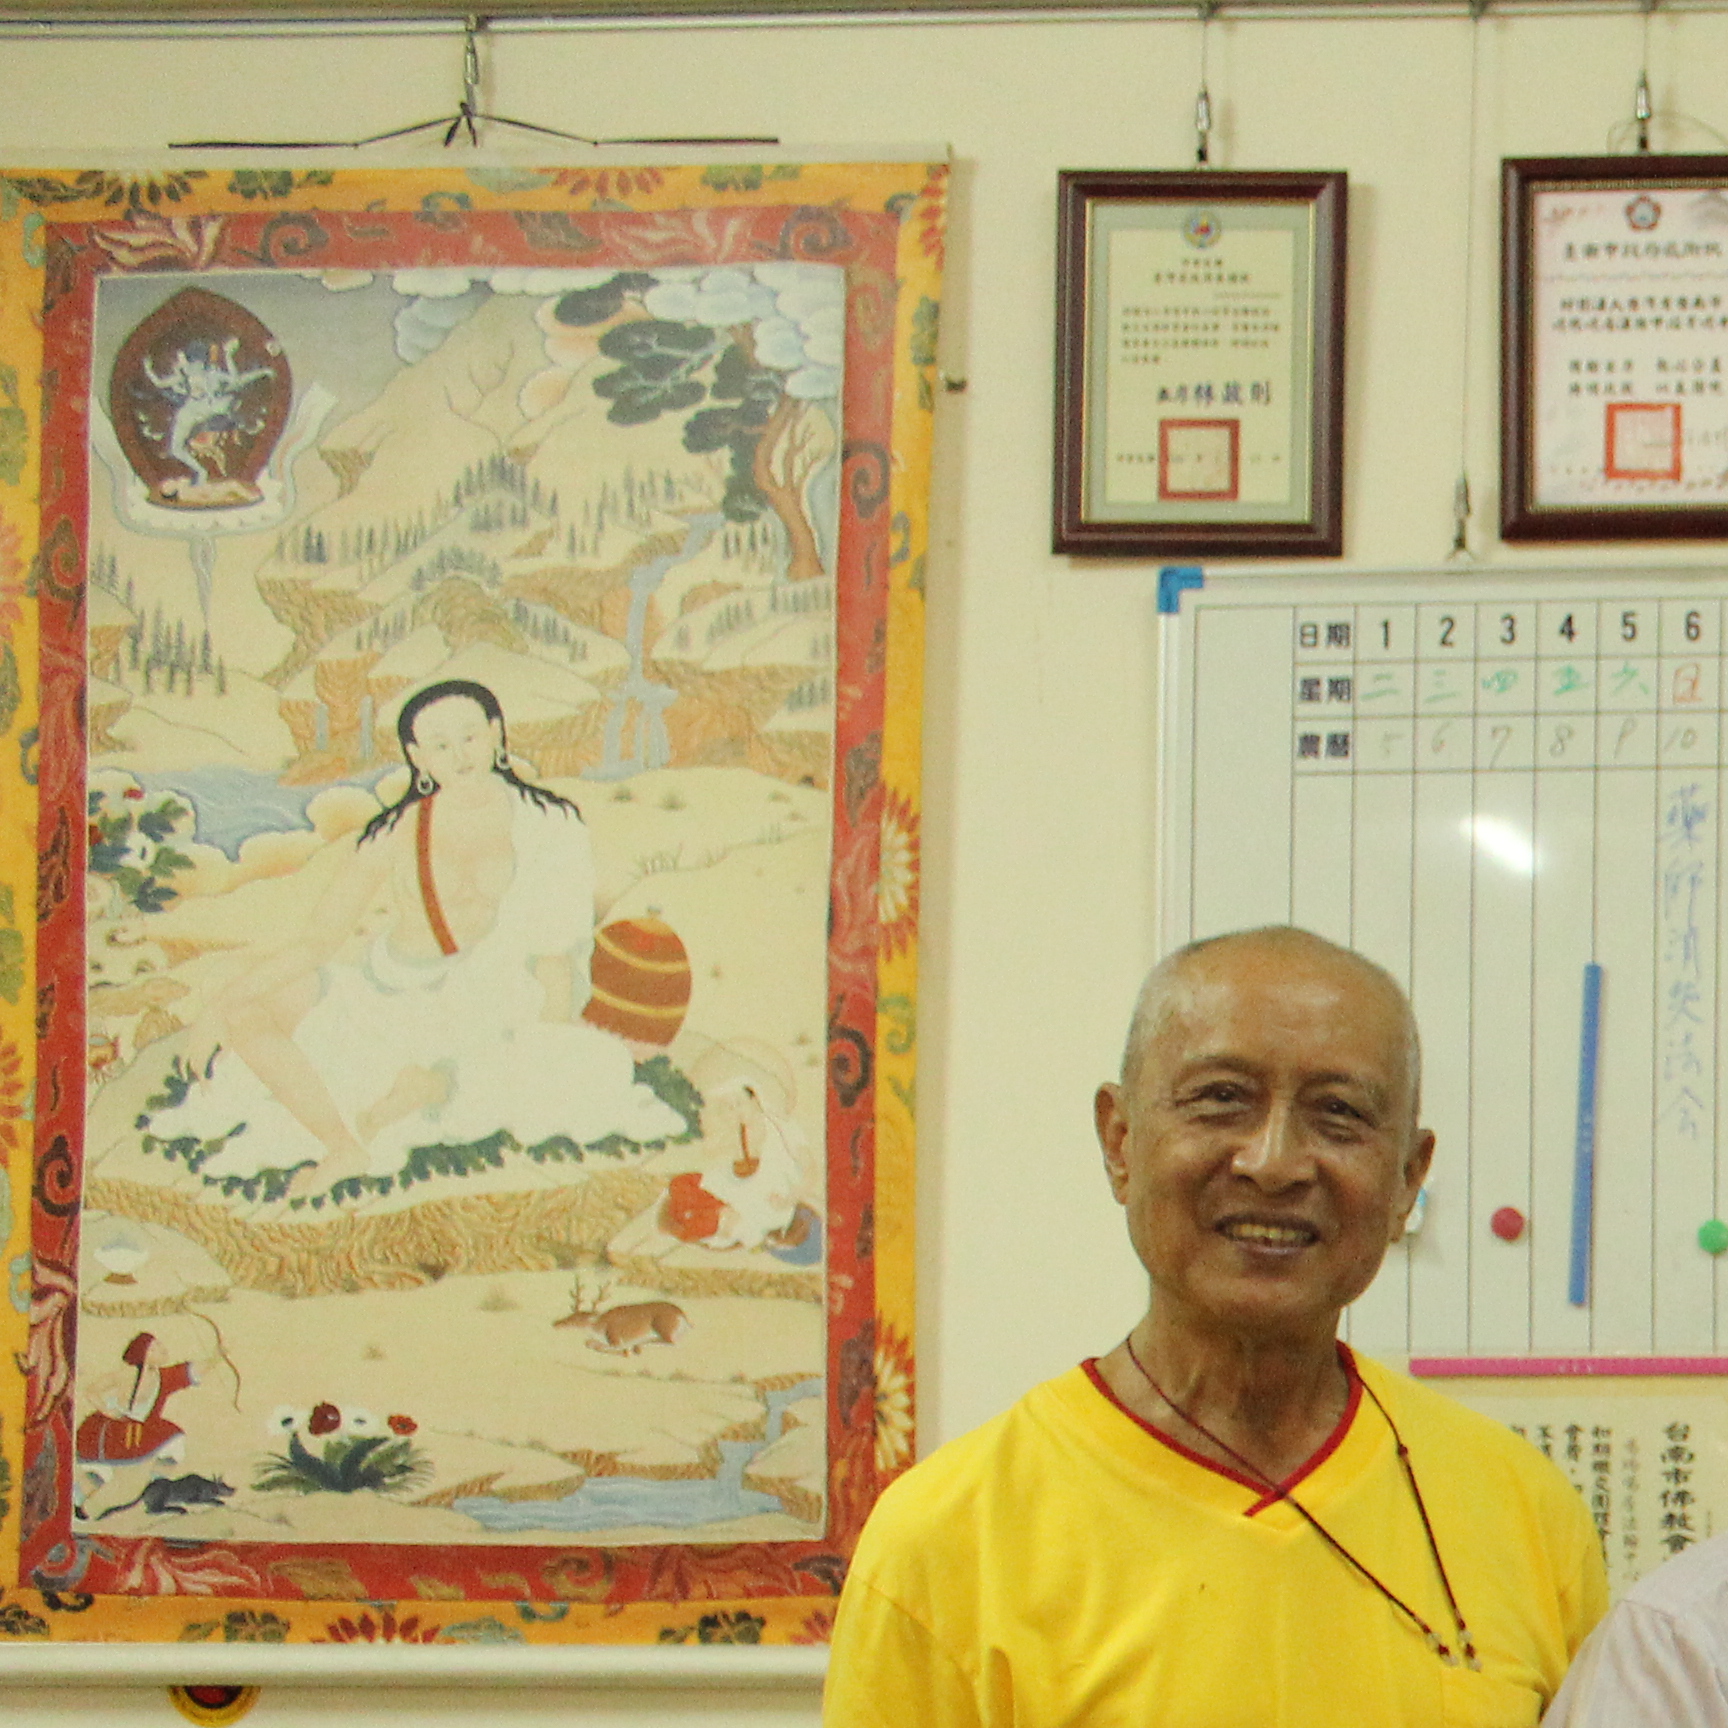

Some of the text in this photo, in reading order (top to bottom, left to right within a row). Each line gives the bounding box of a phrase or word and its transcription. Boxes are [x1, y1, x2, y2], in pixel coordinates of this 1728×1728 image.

[1298, 622, 1349, 648] 日期
[1382, 620, 1390, 649] 1
[1440, 616, 1455, 647] 2
[1501, 614, 1516, 645] 3
[1560, 615, 1575, 641] 4
[1622, 611, 1637, 642] 5
[1685, 610, 1701, 642] 6
[1299, 677, 1348, 703] 星期
[1657, 1421, 1697, 1562] 台南市佛教會
